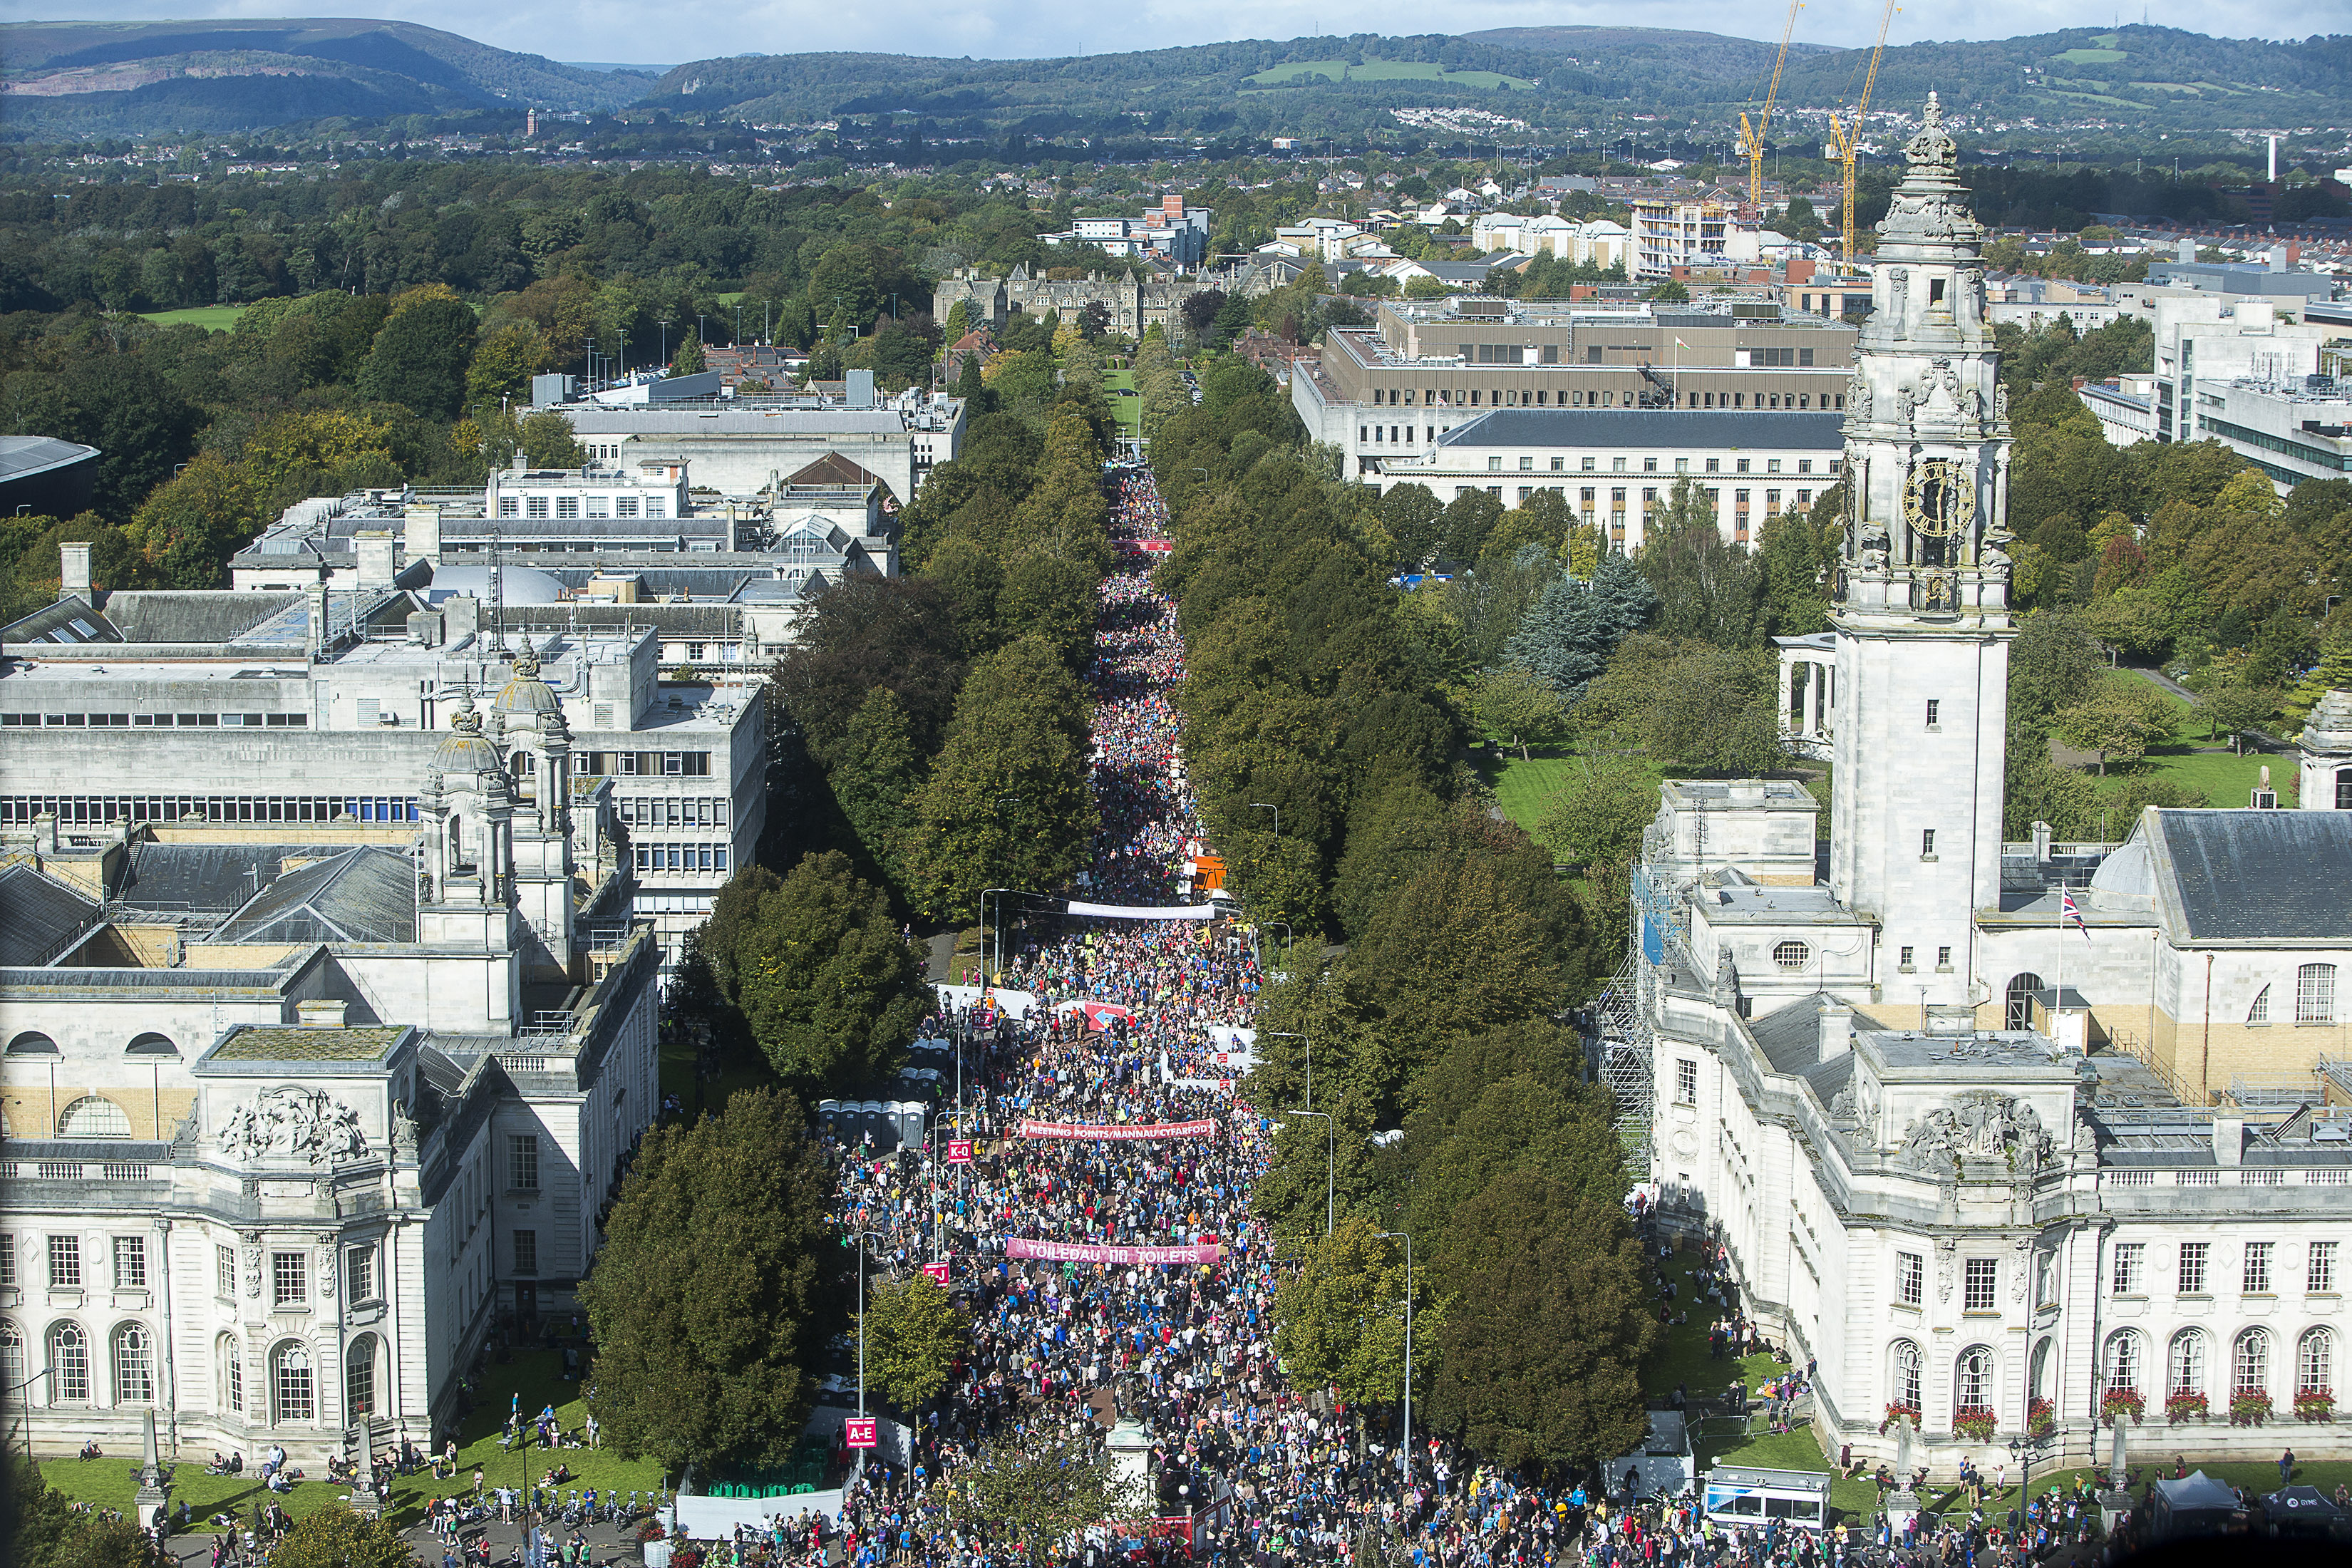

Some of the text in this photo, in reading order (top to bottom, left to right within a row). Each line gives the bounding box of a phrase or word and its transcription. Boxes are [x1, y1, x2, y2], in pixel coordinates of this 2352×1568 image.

[975, 1015, 990, 1024] R-Z
[1028, 1125, 1207, 1138] MEETING POINTS/MANNAU CYFARFOD
[951, 1146, 969, 1157] K-Q
[1029, 1244, 1197, 1262] TOILEDAU TOILETS
[850, 1427, 872, 1440] A-E
